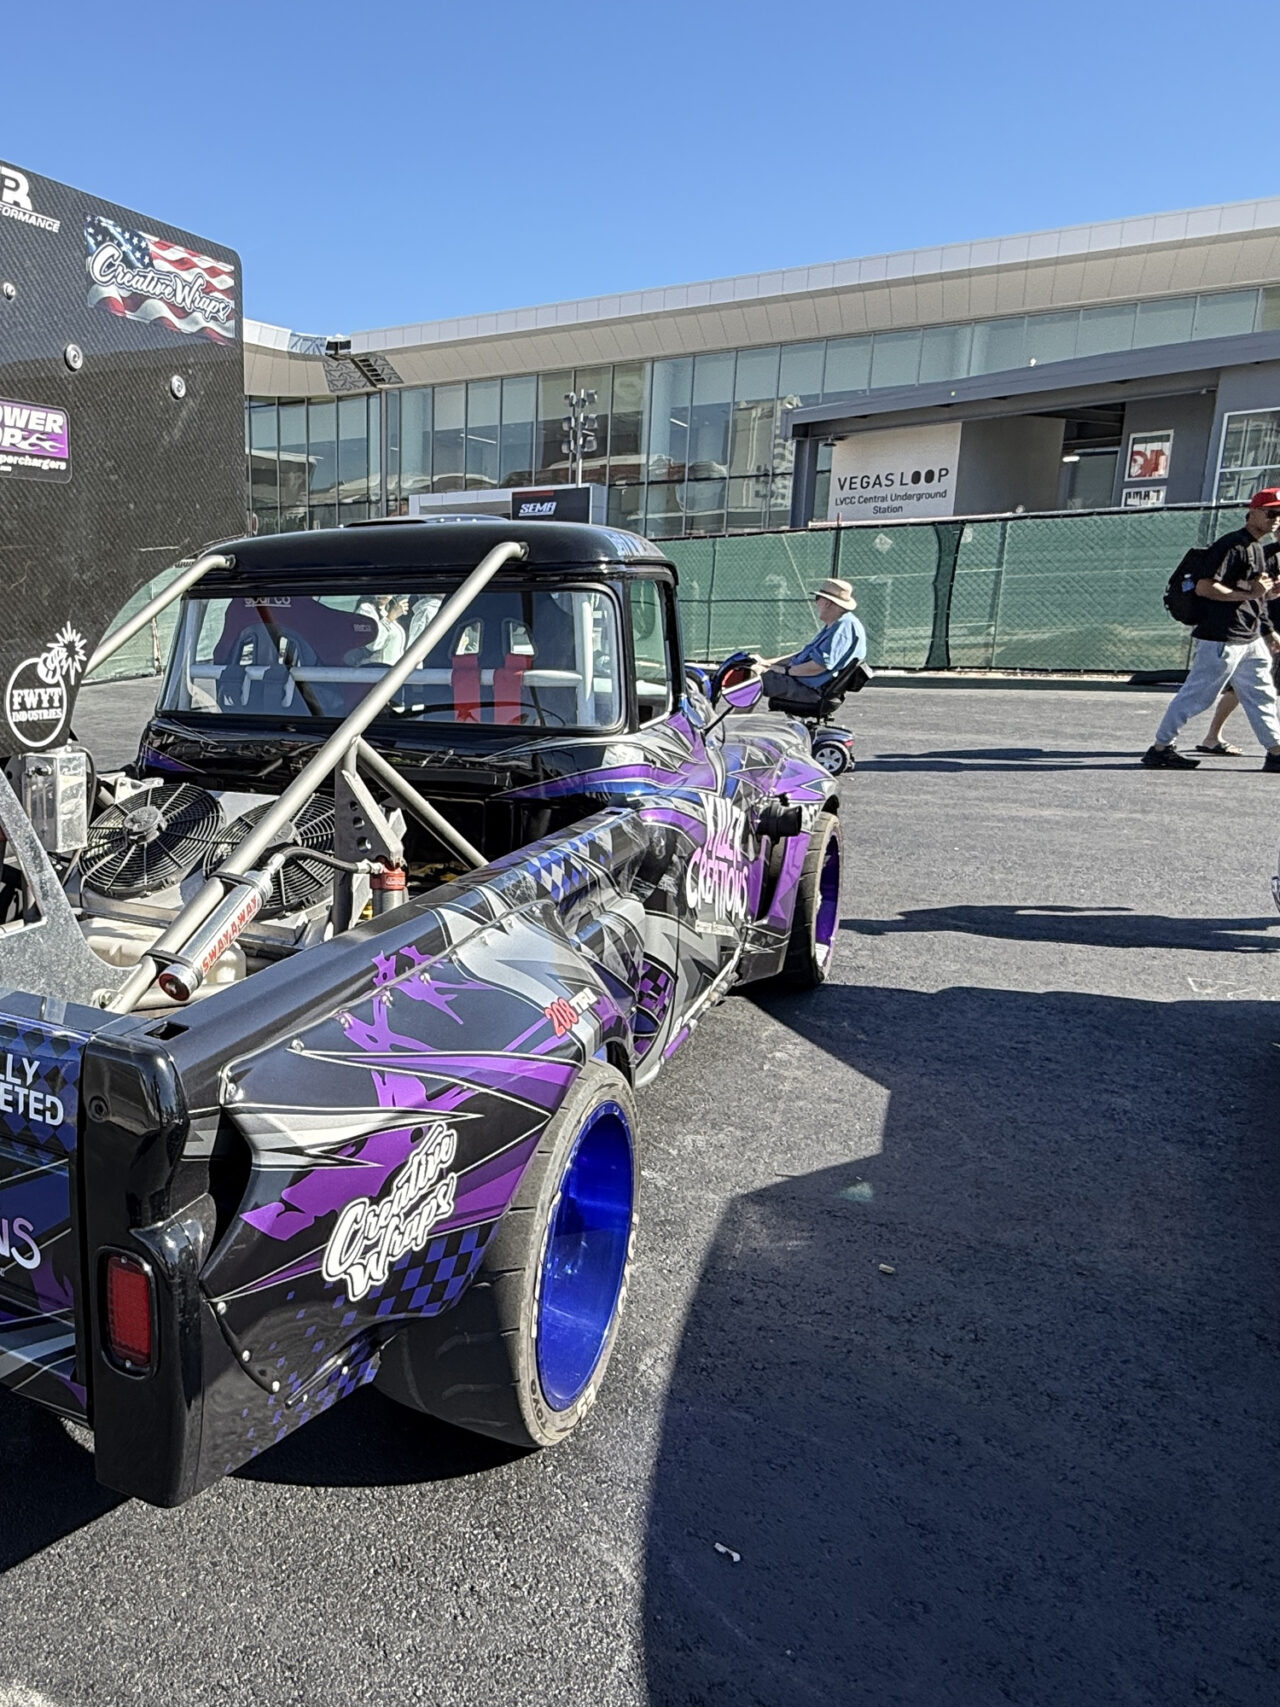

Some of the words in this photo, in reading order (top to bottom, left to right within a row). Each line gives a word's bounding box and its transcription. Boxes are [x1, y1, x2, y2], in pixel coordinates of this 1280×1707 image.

[90, 242, 174, 301] Creative
[173, 273, 231, 322] Wraps
[837, 473, 895, 491] VEGAS
[900, 468, 949, 486] LOOP
[519, 502, 557, 514] SEMA
[835, 496, 856, 506] LVCC
[857, 495, 888, 504] Central
[890, 490, 947, 501] Underground
[872, 505, 903, 514] Station
[12, 688, 61, 710] FWYT
[12, 708, 62, 722] INDUSTRIES
[699, 793, 745, 868] KILLER
[686, 847, 748, 922] CREATIONS
[323, 1121, 457, 1281] Creative
[347, 1173, 457, 1301] Wraps
